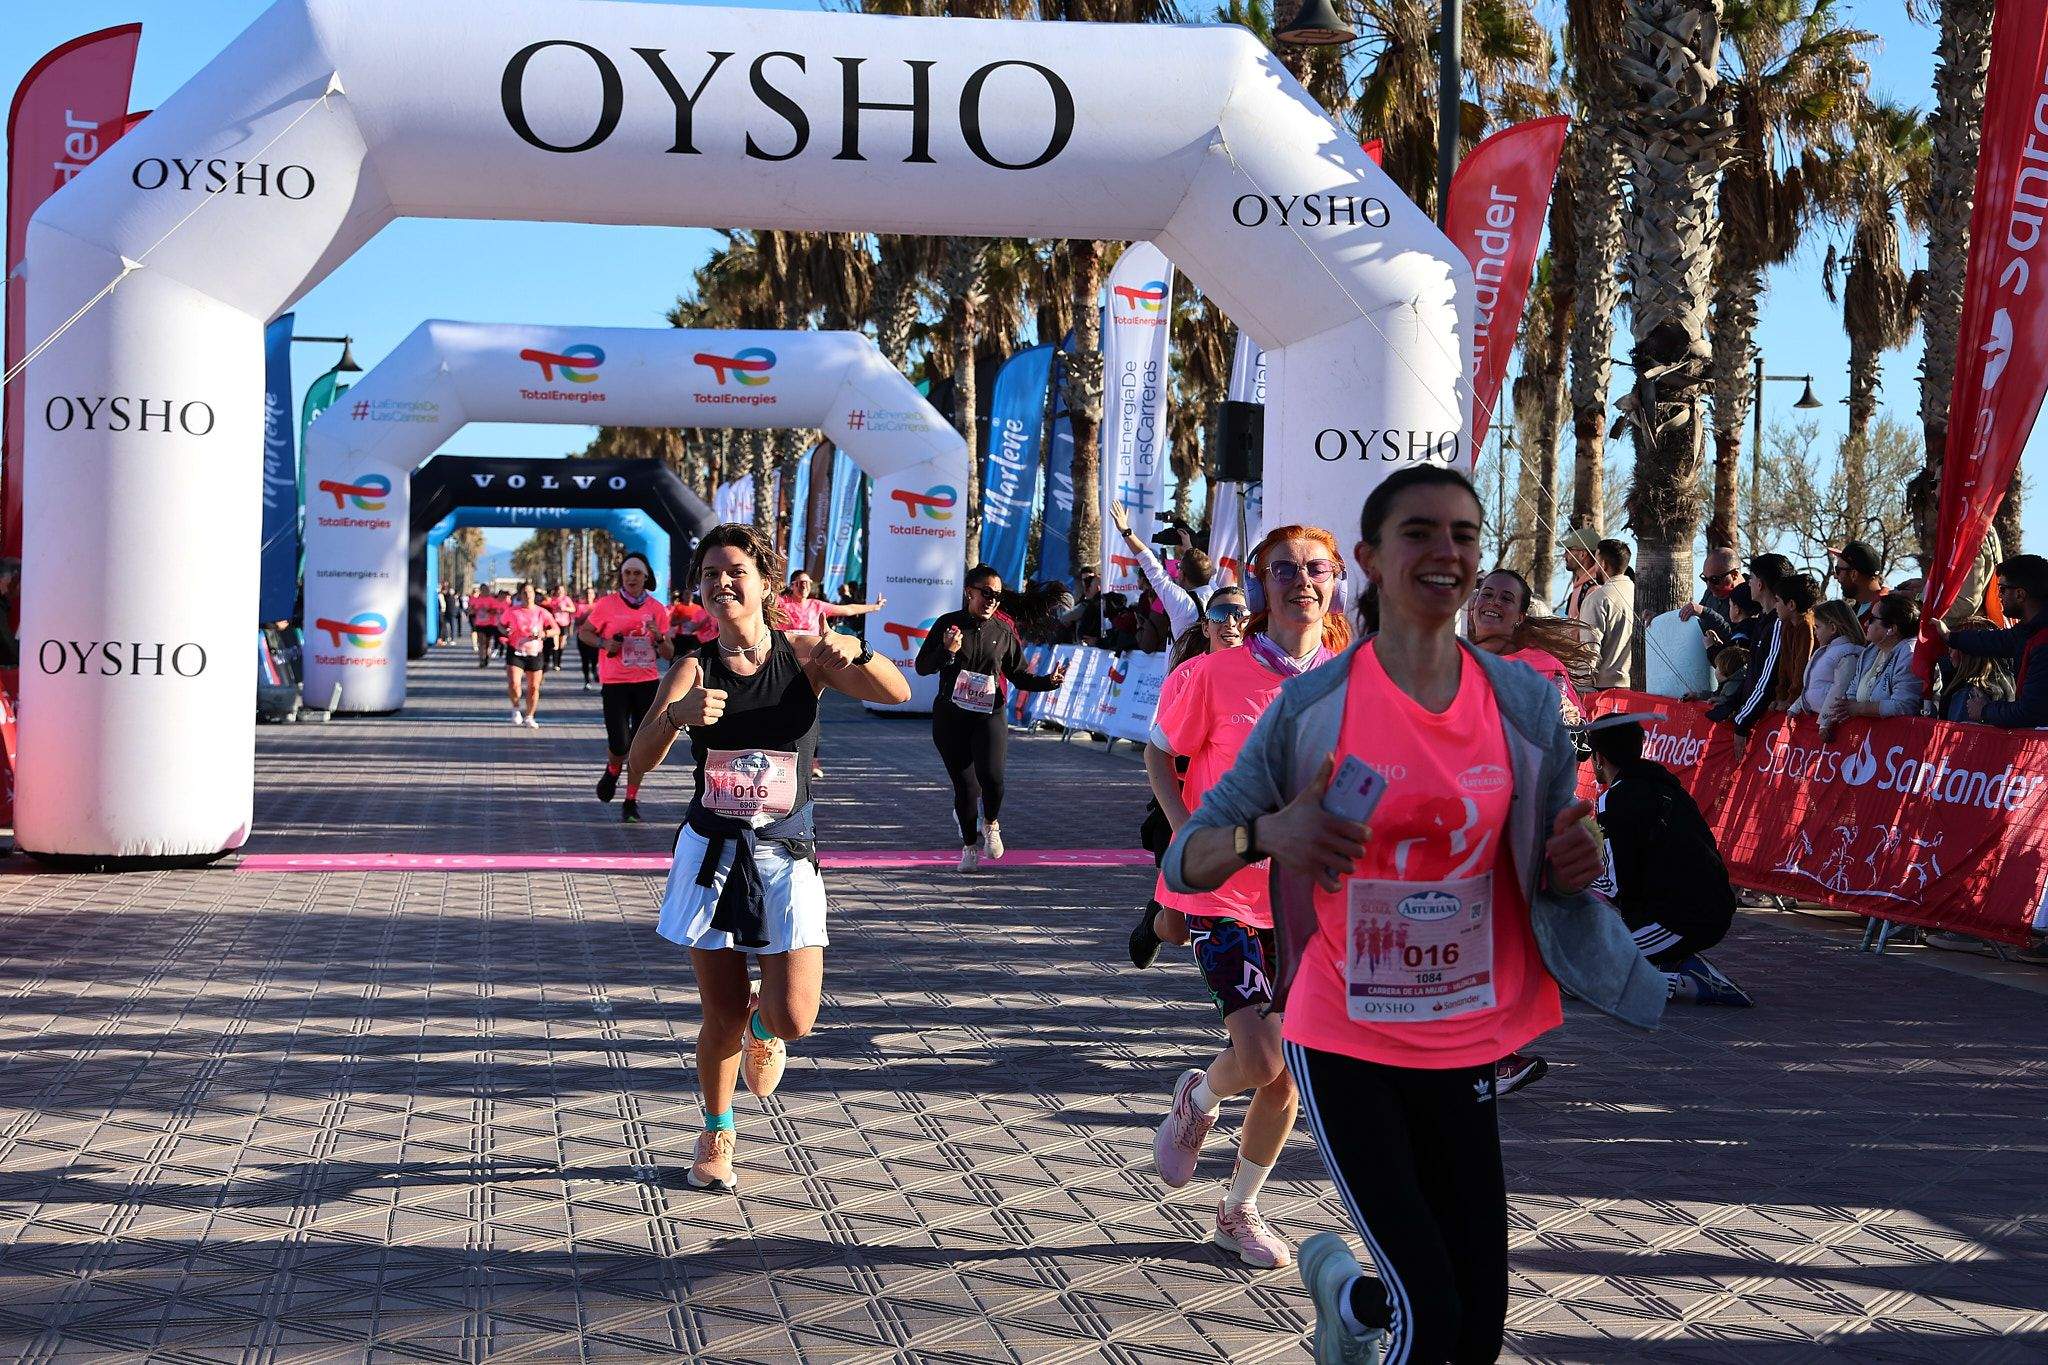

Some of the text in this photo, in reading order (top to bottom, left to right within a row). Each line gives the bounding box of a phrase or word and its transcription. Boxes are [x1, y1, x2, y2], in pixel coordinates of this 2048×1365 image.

[501, 38, 1075, 171] OYSHO
[132, 157, 315, 200] OYSHO
[1232, 194, 1391, 228] OYSHO
[1113, 314, 1168, 327] TotalEnergies
[520, 389, 606, 403] TotalEnergies
[693, 393, 777, 405] TotalEnergies
[46, 396, 215, 436] OYSHO
[1136, 360, 1158, 477] LasCarreras
[1314, 428, 1459, 463] OYSHO
[983, 418, 1032, 528] Marlene
[471, 473, 627, 490] VOLVO
[317, 517, 391, 530] TotalEnergies
[889, 525, 956, 539] TotalEnergies
[39, 639, 207, 677] OYSHO
[314, 654, 388, 667] TotalEnergies
[1758, 730, 2045, 812] Sports Santander
[733, 784, 769, 799] 016
[1402, 902, 1458, 915] ASTURIANA
[1403, 942, 1460, 968] 016
[1415, 972, 1442, 984] 1084
[1402, 987, 1413, 996] DE
[1414, 987, 1424, 996] LA
[1365, 1001, 1415, 1014] OYSHO
